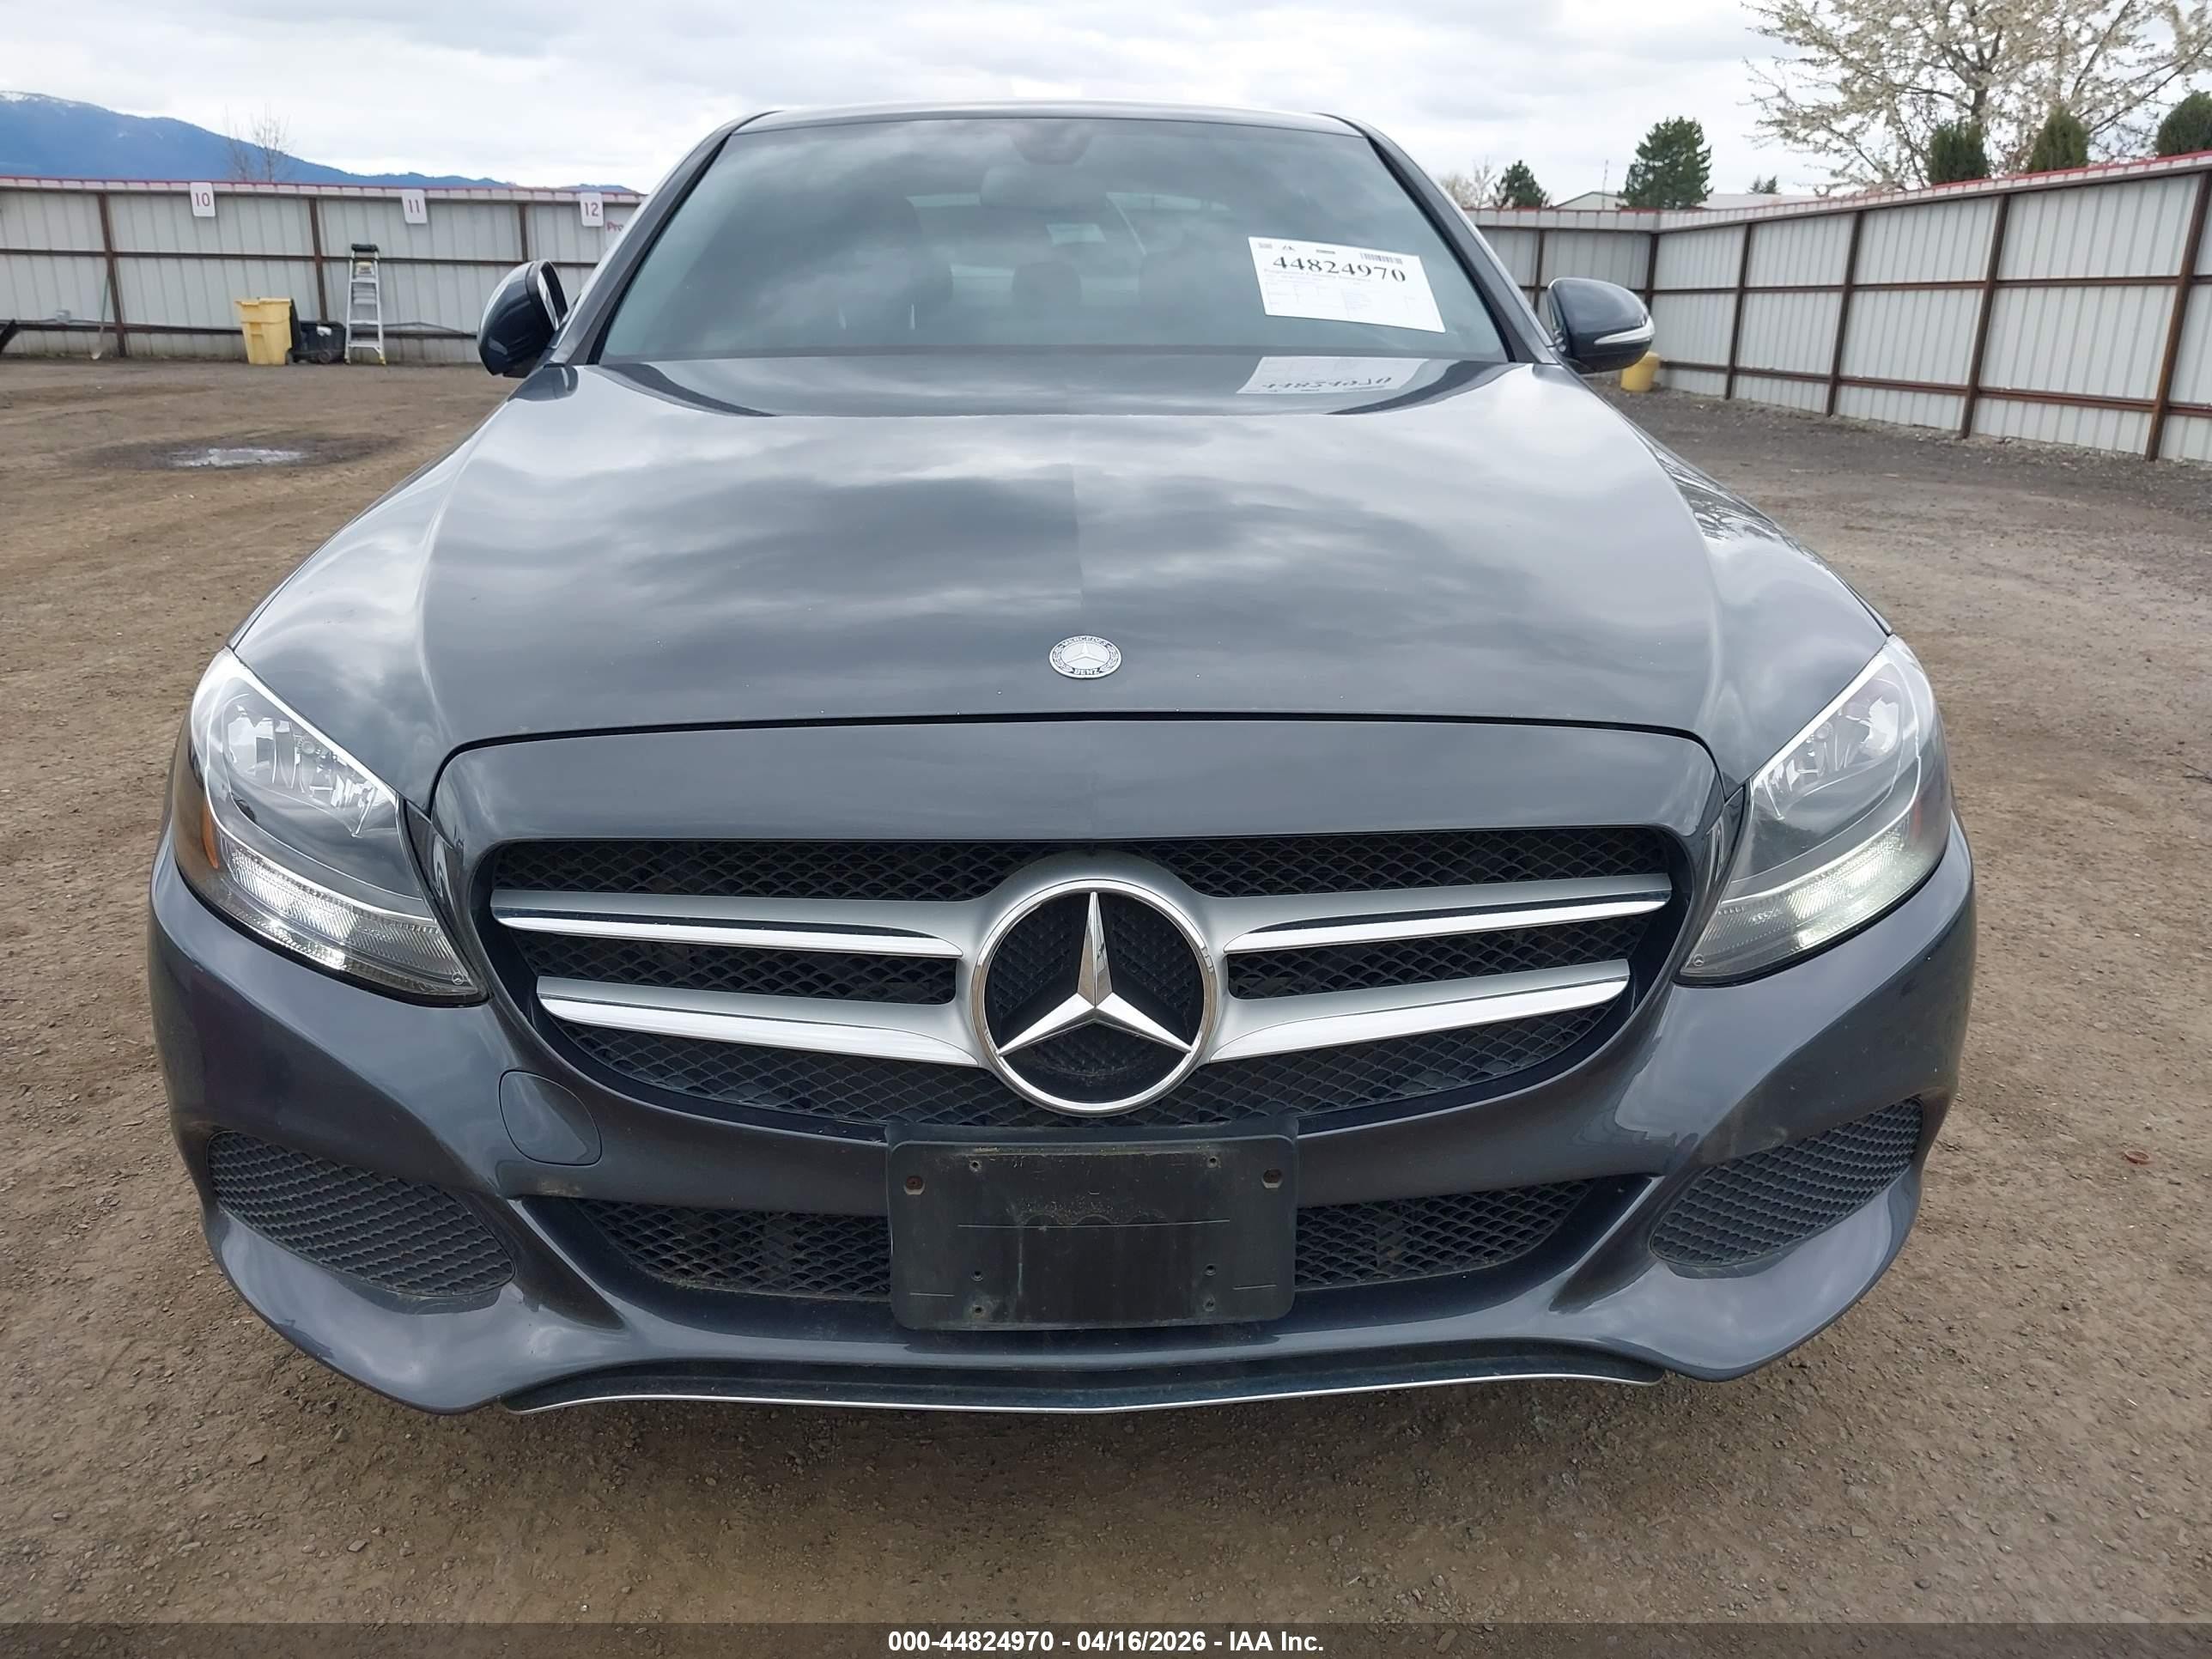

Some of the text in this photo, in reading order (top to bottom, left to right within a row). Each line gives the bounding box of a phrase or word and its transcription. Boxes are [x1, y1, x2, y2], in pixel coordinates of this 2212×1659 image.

[196, 191, 210, 207] 10
[408, 198, 420, 214] 11
[584, 202, 599, 216] 12
[1273, 256, 1407, 283] 44824970
